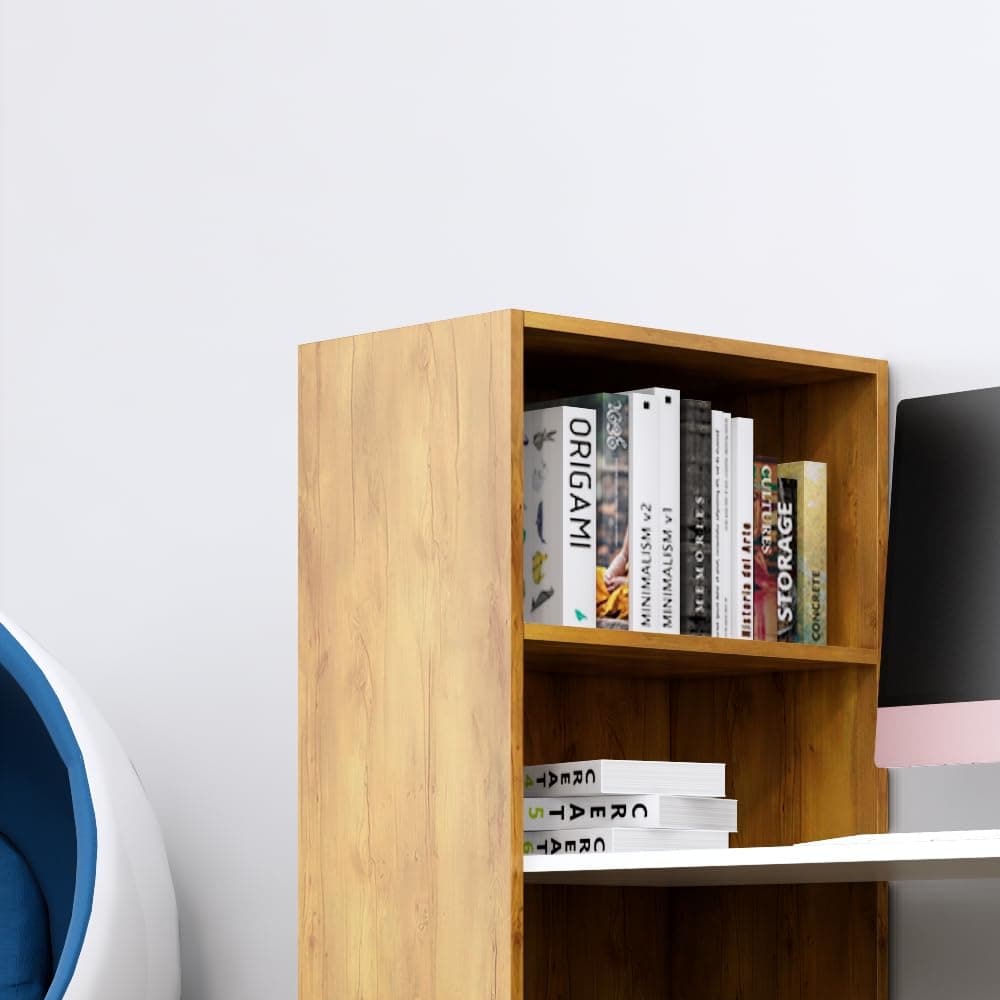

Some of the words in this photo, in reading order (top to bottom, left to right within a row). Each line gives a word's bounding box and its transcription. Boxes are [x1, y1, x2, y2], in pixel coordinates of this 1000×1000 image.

[569, 418, 592, 549] ORIGAMI
[641, 503, 652, 519] v2
[761, 465, 773, 554] CULTURES
[641, 527, 653, 627] MINIMALISM
[662, 528, 673, 629] MINIMALISM
[777, 502, 793, 622] STORAGE
[812, 570, 822, 642] CONCRETE
[528, 807, 544, 820] 5
[536, 769, 596, 788] CREAT
[548, 803, 648, 821] CREAT
